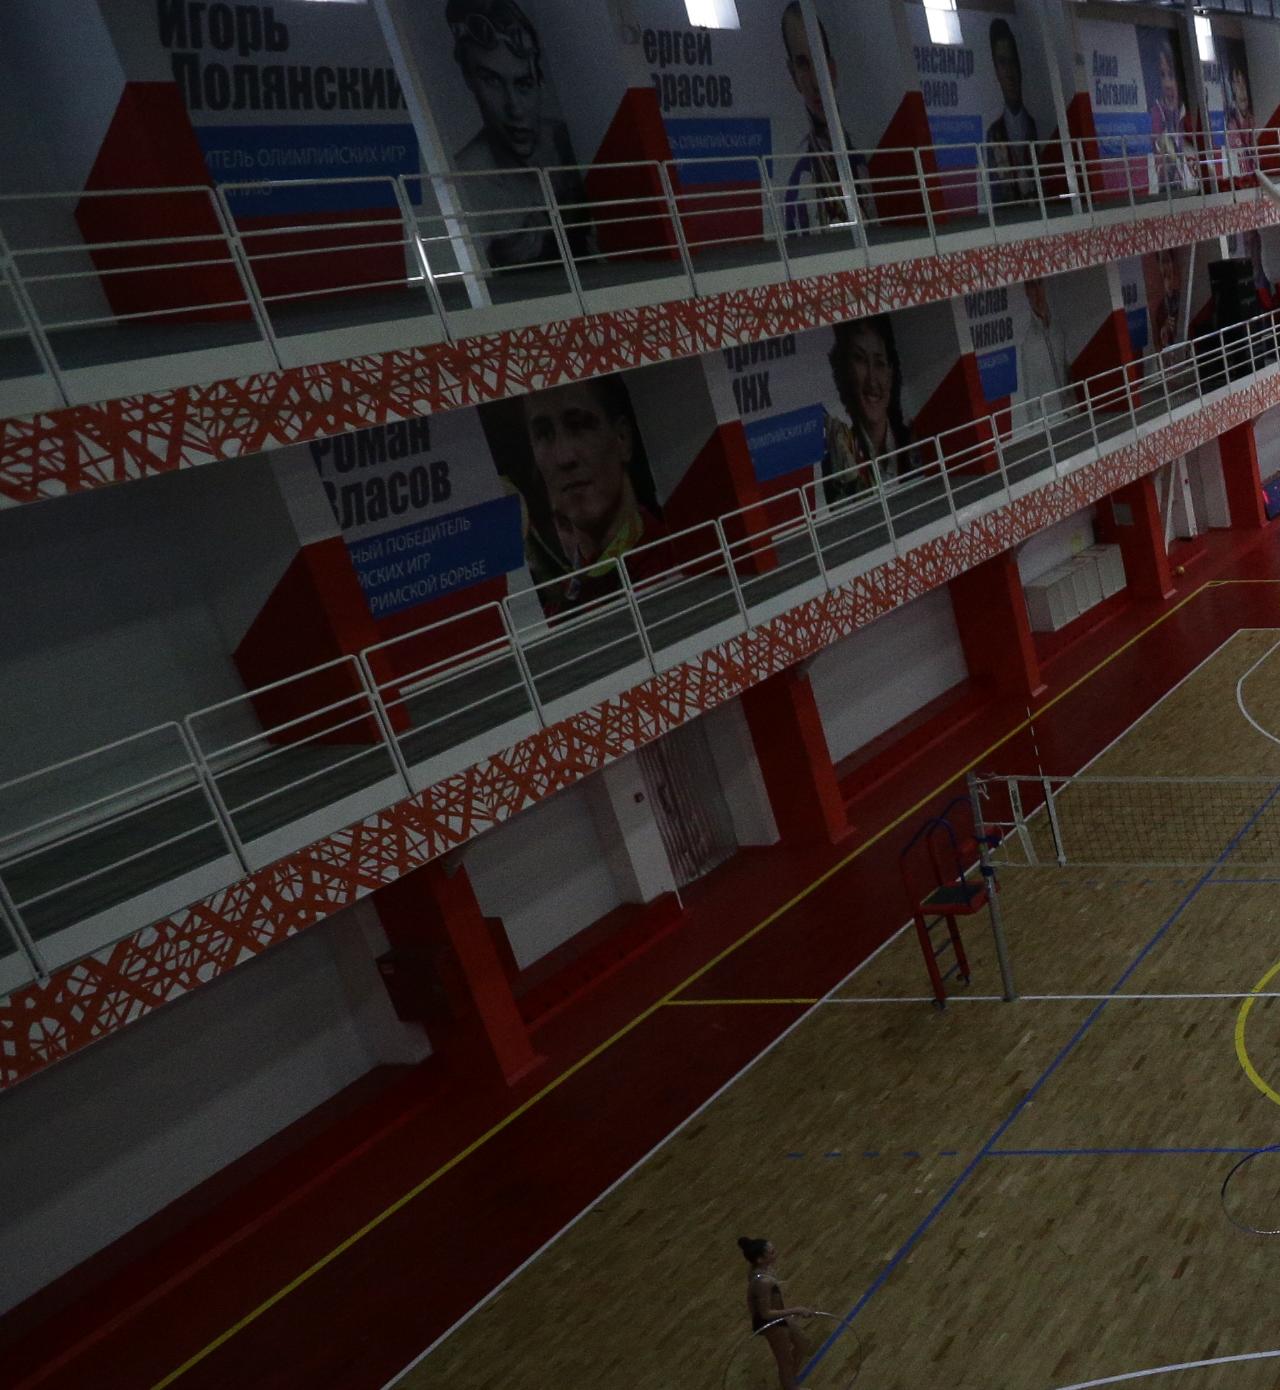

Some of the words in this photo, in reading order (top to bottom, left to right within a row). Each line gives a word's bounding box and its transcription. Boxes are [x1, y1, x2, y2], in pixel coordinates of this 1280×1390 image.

[386, 516, 472, 556] ПОБЕДИТЕЛЬ
[407, 552, 432, 575] ИГР
[370, 573, 438, 614] РИМСКОЙ
[440, 559, 487, 589] БОРЬБЕ
